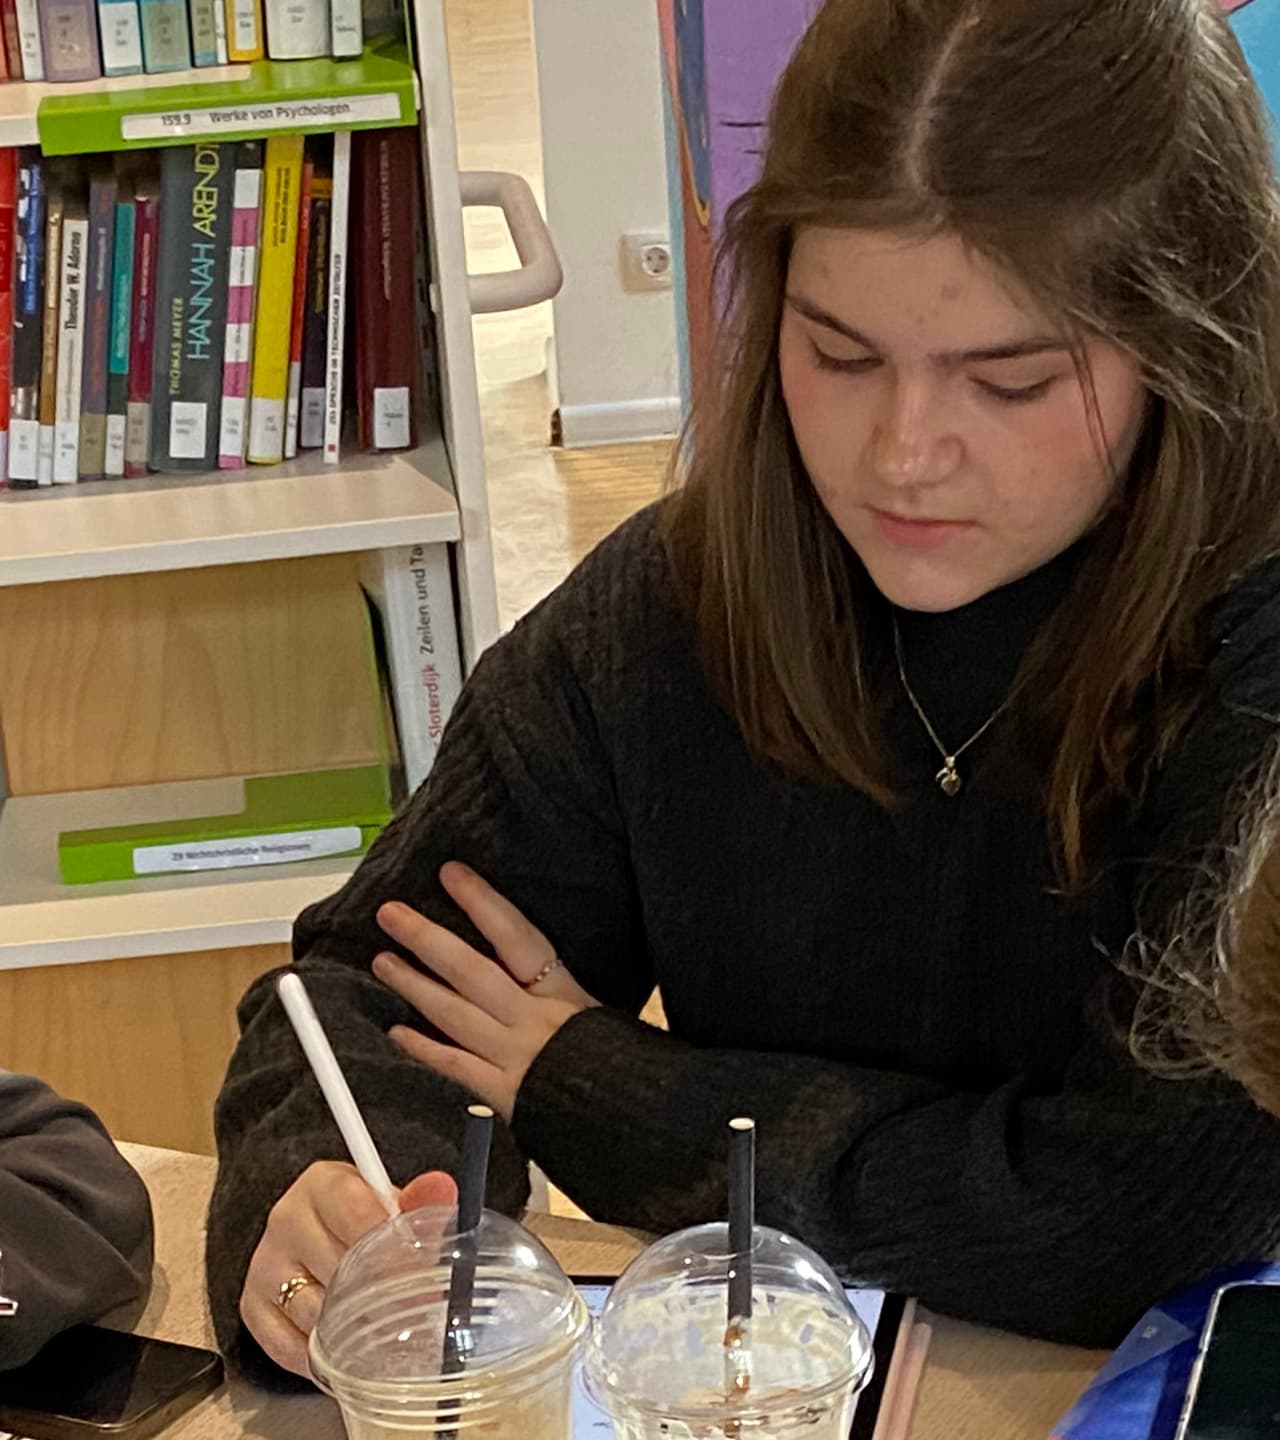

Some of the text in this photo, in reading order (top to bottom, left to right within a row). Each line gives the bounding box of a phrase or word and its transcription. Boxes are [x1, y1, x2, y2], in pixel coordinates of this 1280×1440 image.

[209, 109, 249, 124] Werke
[251, 110, 274, 122] von
[276, 101, 351, 120] Psychologen
[63, 231, 82, 330] Theodor W. Adorno
[187, 142, 217, 359] HANNAH ARENDT
[169, 298, 184, 395] THOMAS MEYER
[411, 568, 427, 598] und
[417, 605, 434, 655] Zeilen
[422, 663, 442, 738] Sloterdijk
